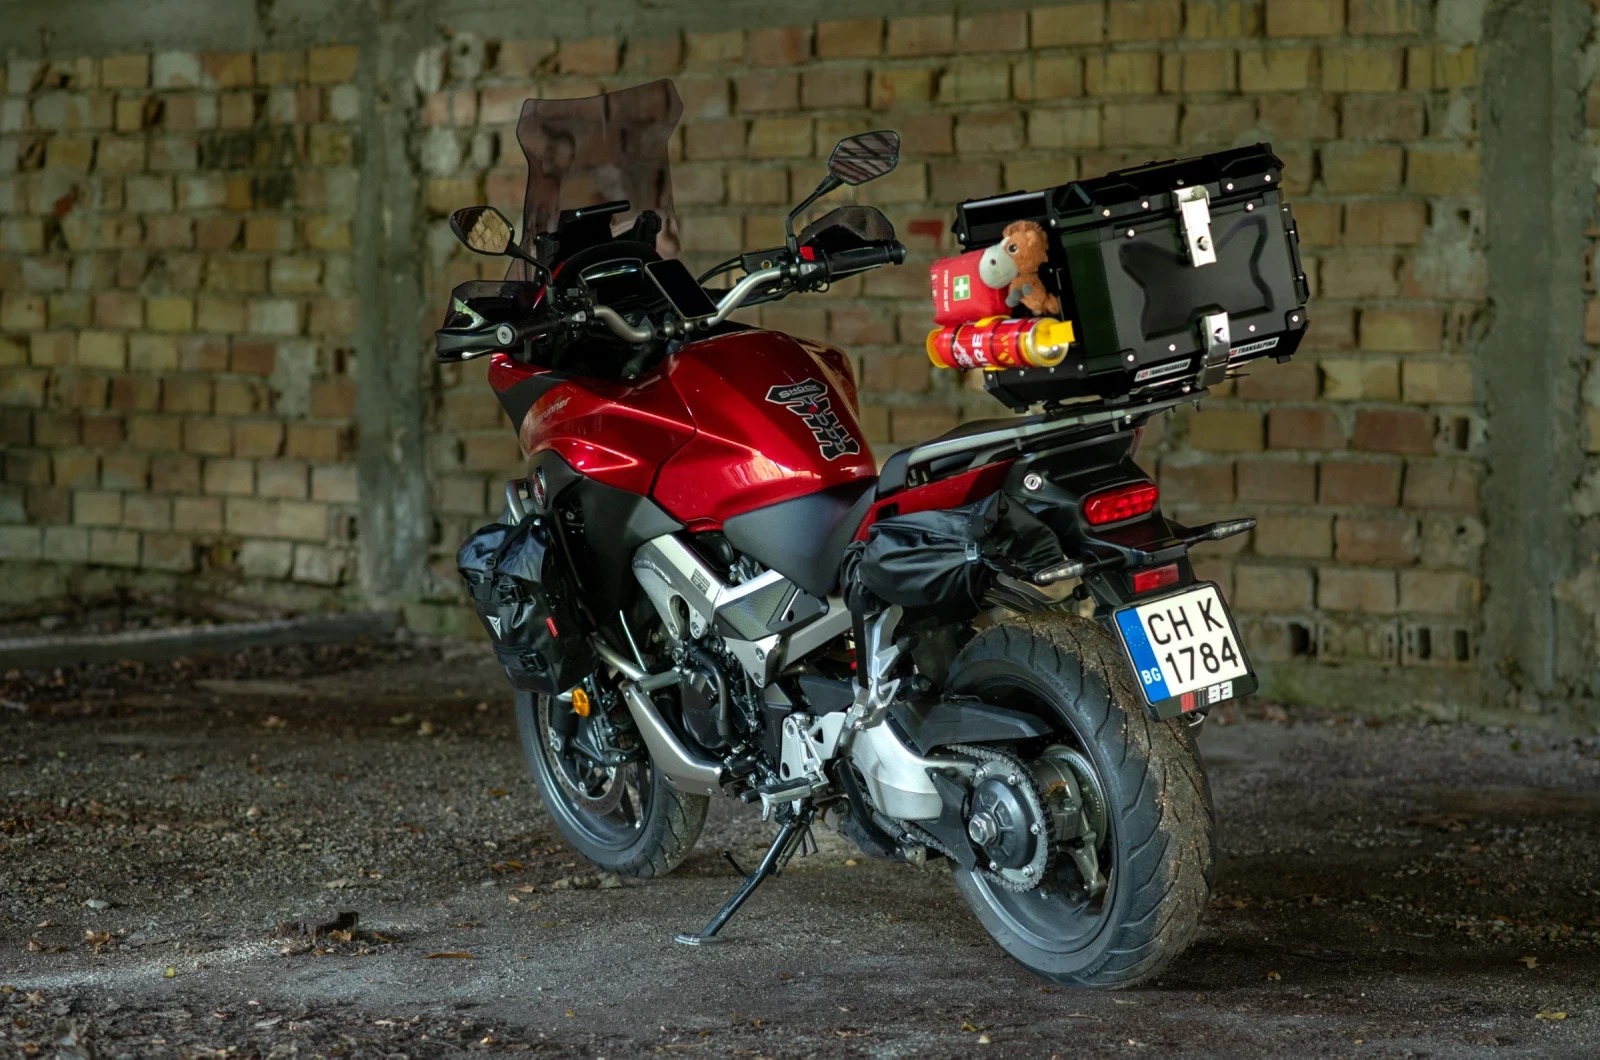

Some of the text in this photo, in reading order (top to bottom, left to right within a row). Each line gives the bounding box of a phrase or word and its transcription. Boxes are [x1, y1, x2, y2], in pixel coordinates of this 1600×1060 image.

[778, 384, 819, 399] SHOCK
[1147, 597, 1224, 645] CH K
[1141, 667, 1162, 685] BG
[1165, 636, 1239, 684] 1784
